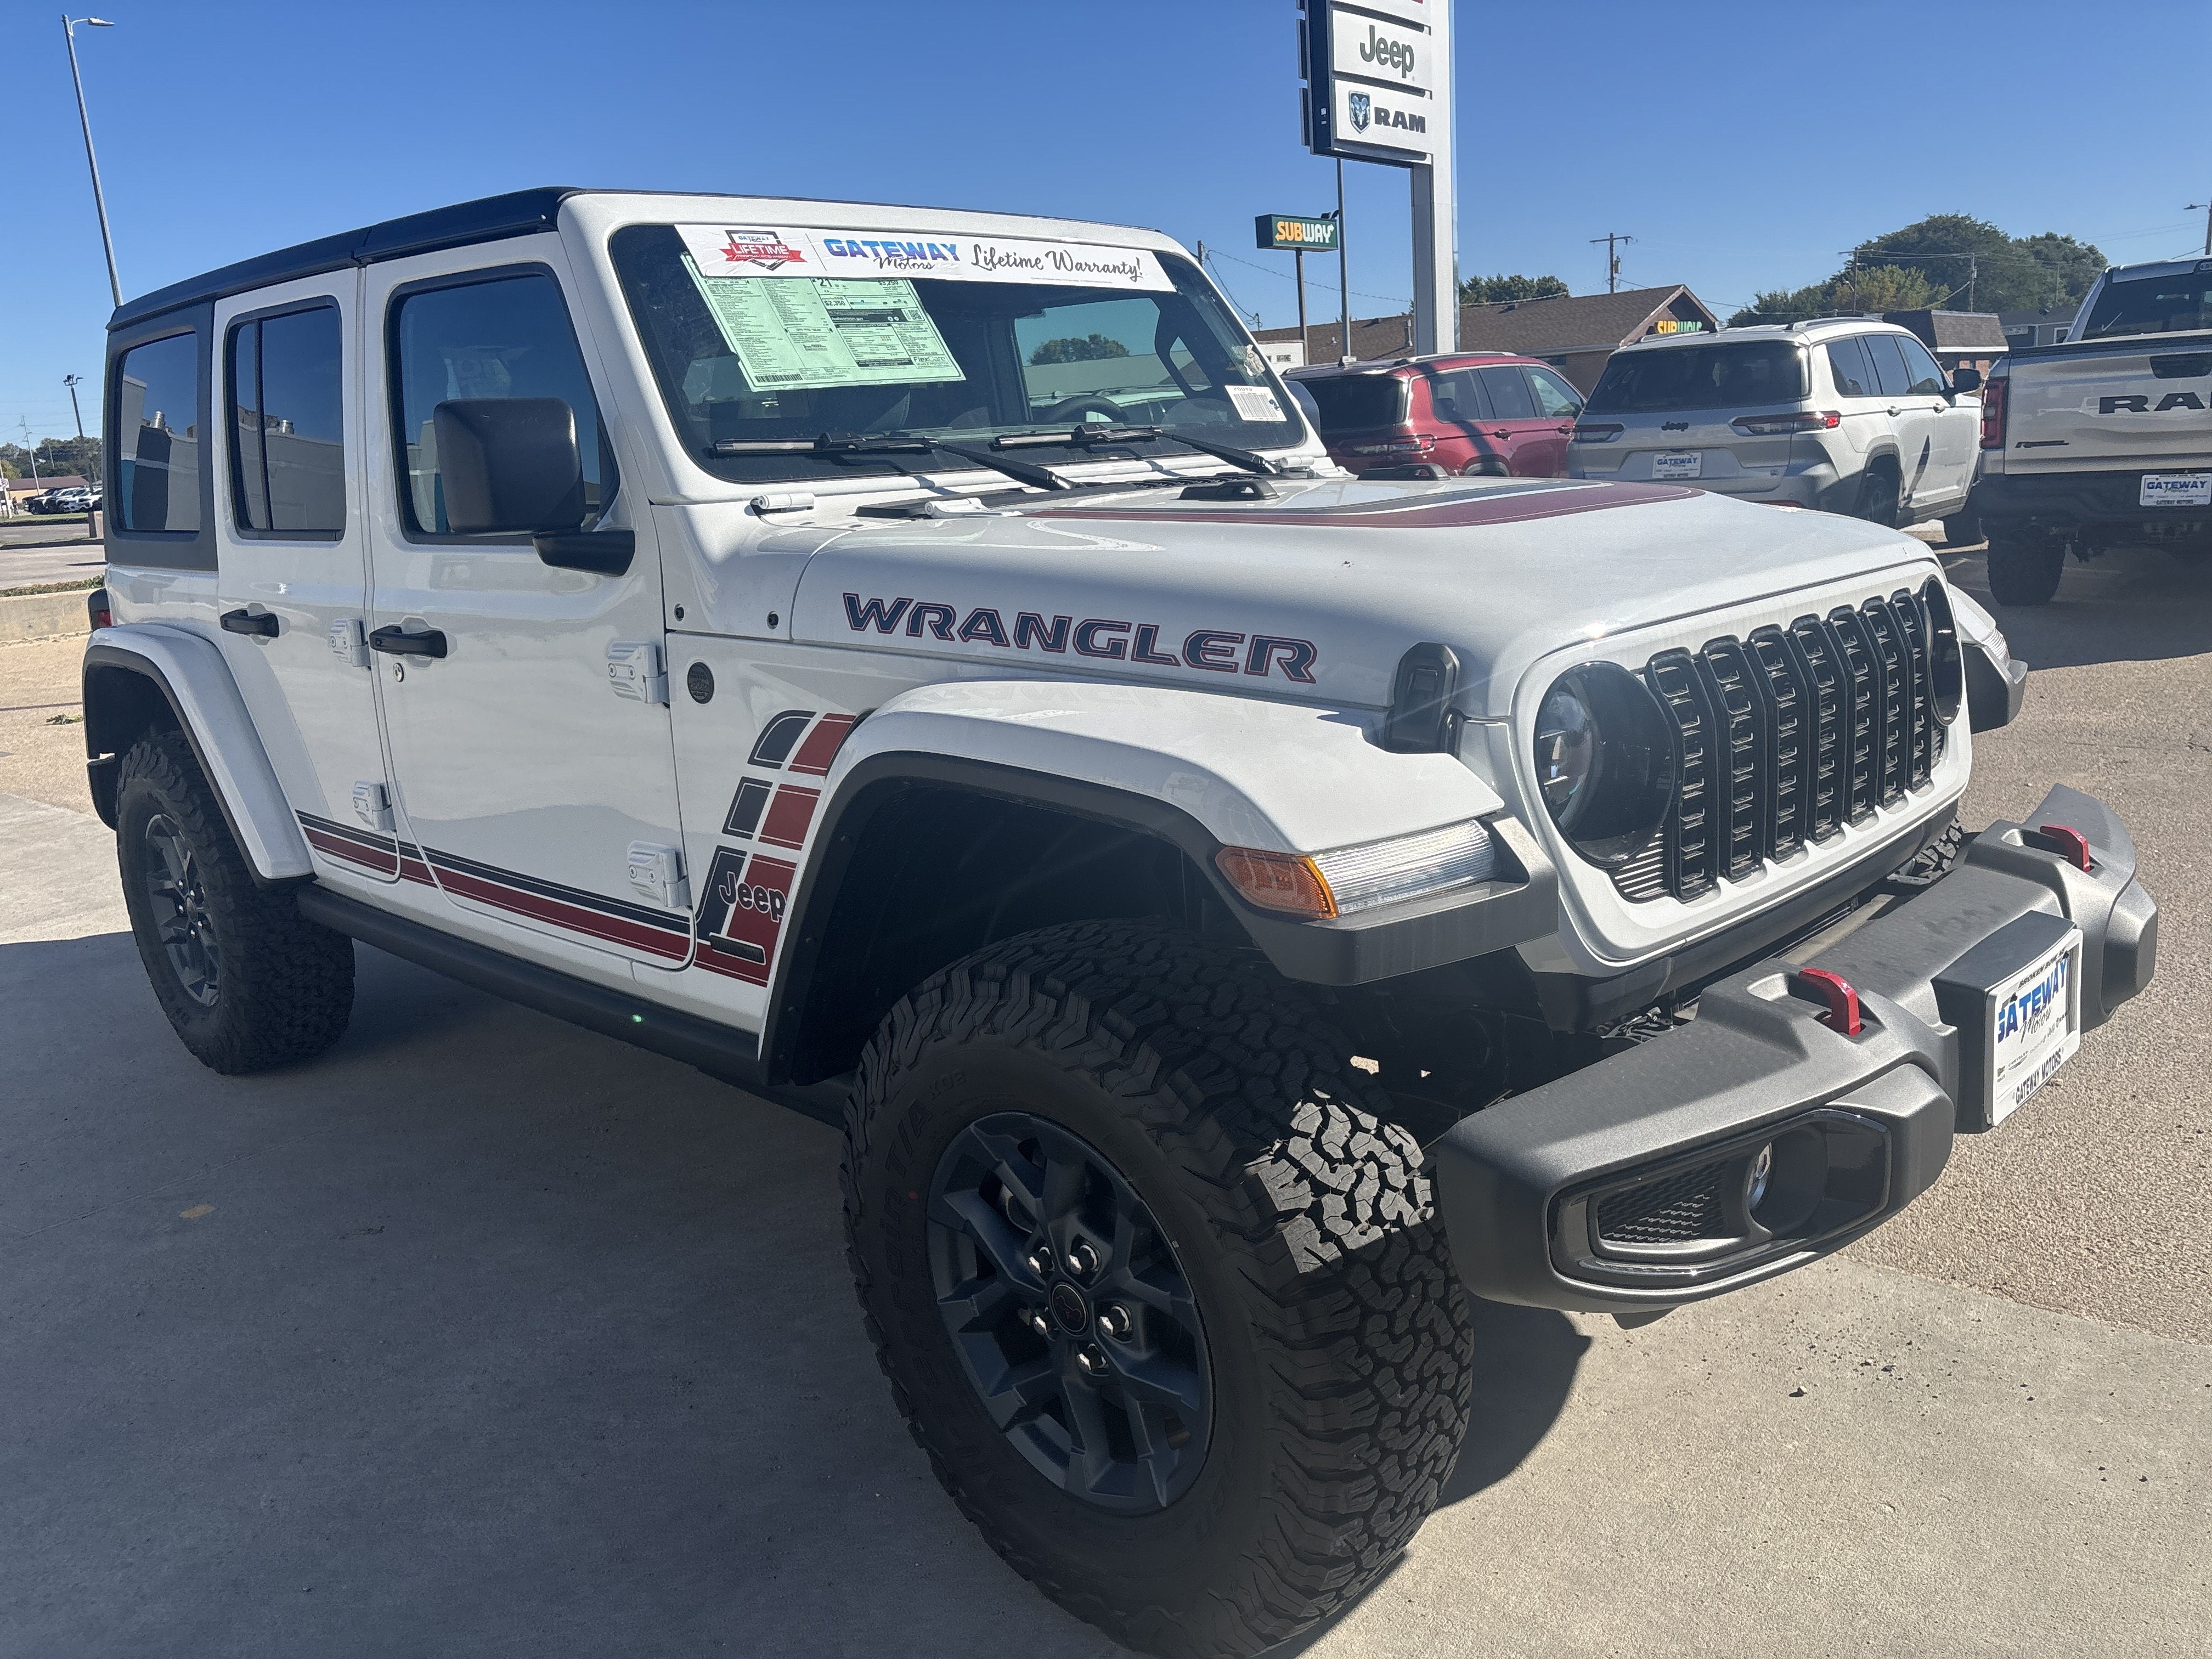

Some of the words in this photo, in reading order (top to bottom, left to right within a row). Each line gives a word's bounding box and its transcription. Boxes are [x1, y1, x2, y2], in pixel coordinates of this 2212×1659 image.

[1360, 25, 1414, 78] Jeep
[1374, 106, 1426, 133] RAM
[1275, 221, 1335, 243] SUBWAY
[731, 245, 789, 255] LIFETIME
[823, 239, 960, 261] GATEWAY
[873, 256, 935, 270] Motors
[971, 244, 1044, 272] Lifetime
[1045, 250, 1144, 282] Warranty!
[2099, 392, 2212, 414] RA
[1661, 421, 1689, 432] Jeep
[1657, 457, 1698, 465] GATEWAY
[2147, 481, 2207, 489] GATEWAY
[843, 592, 1317, 684] WRANGLER
[719, 871, 787, 923] Jeep
[2016, 1066, 2040, 1105] GATEWAY
[2041, 1047, 2061, 1082] MOTORS
